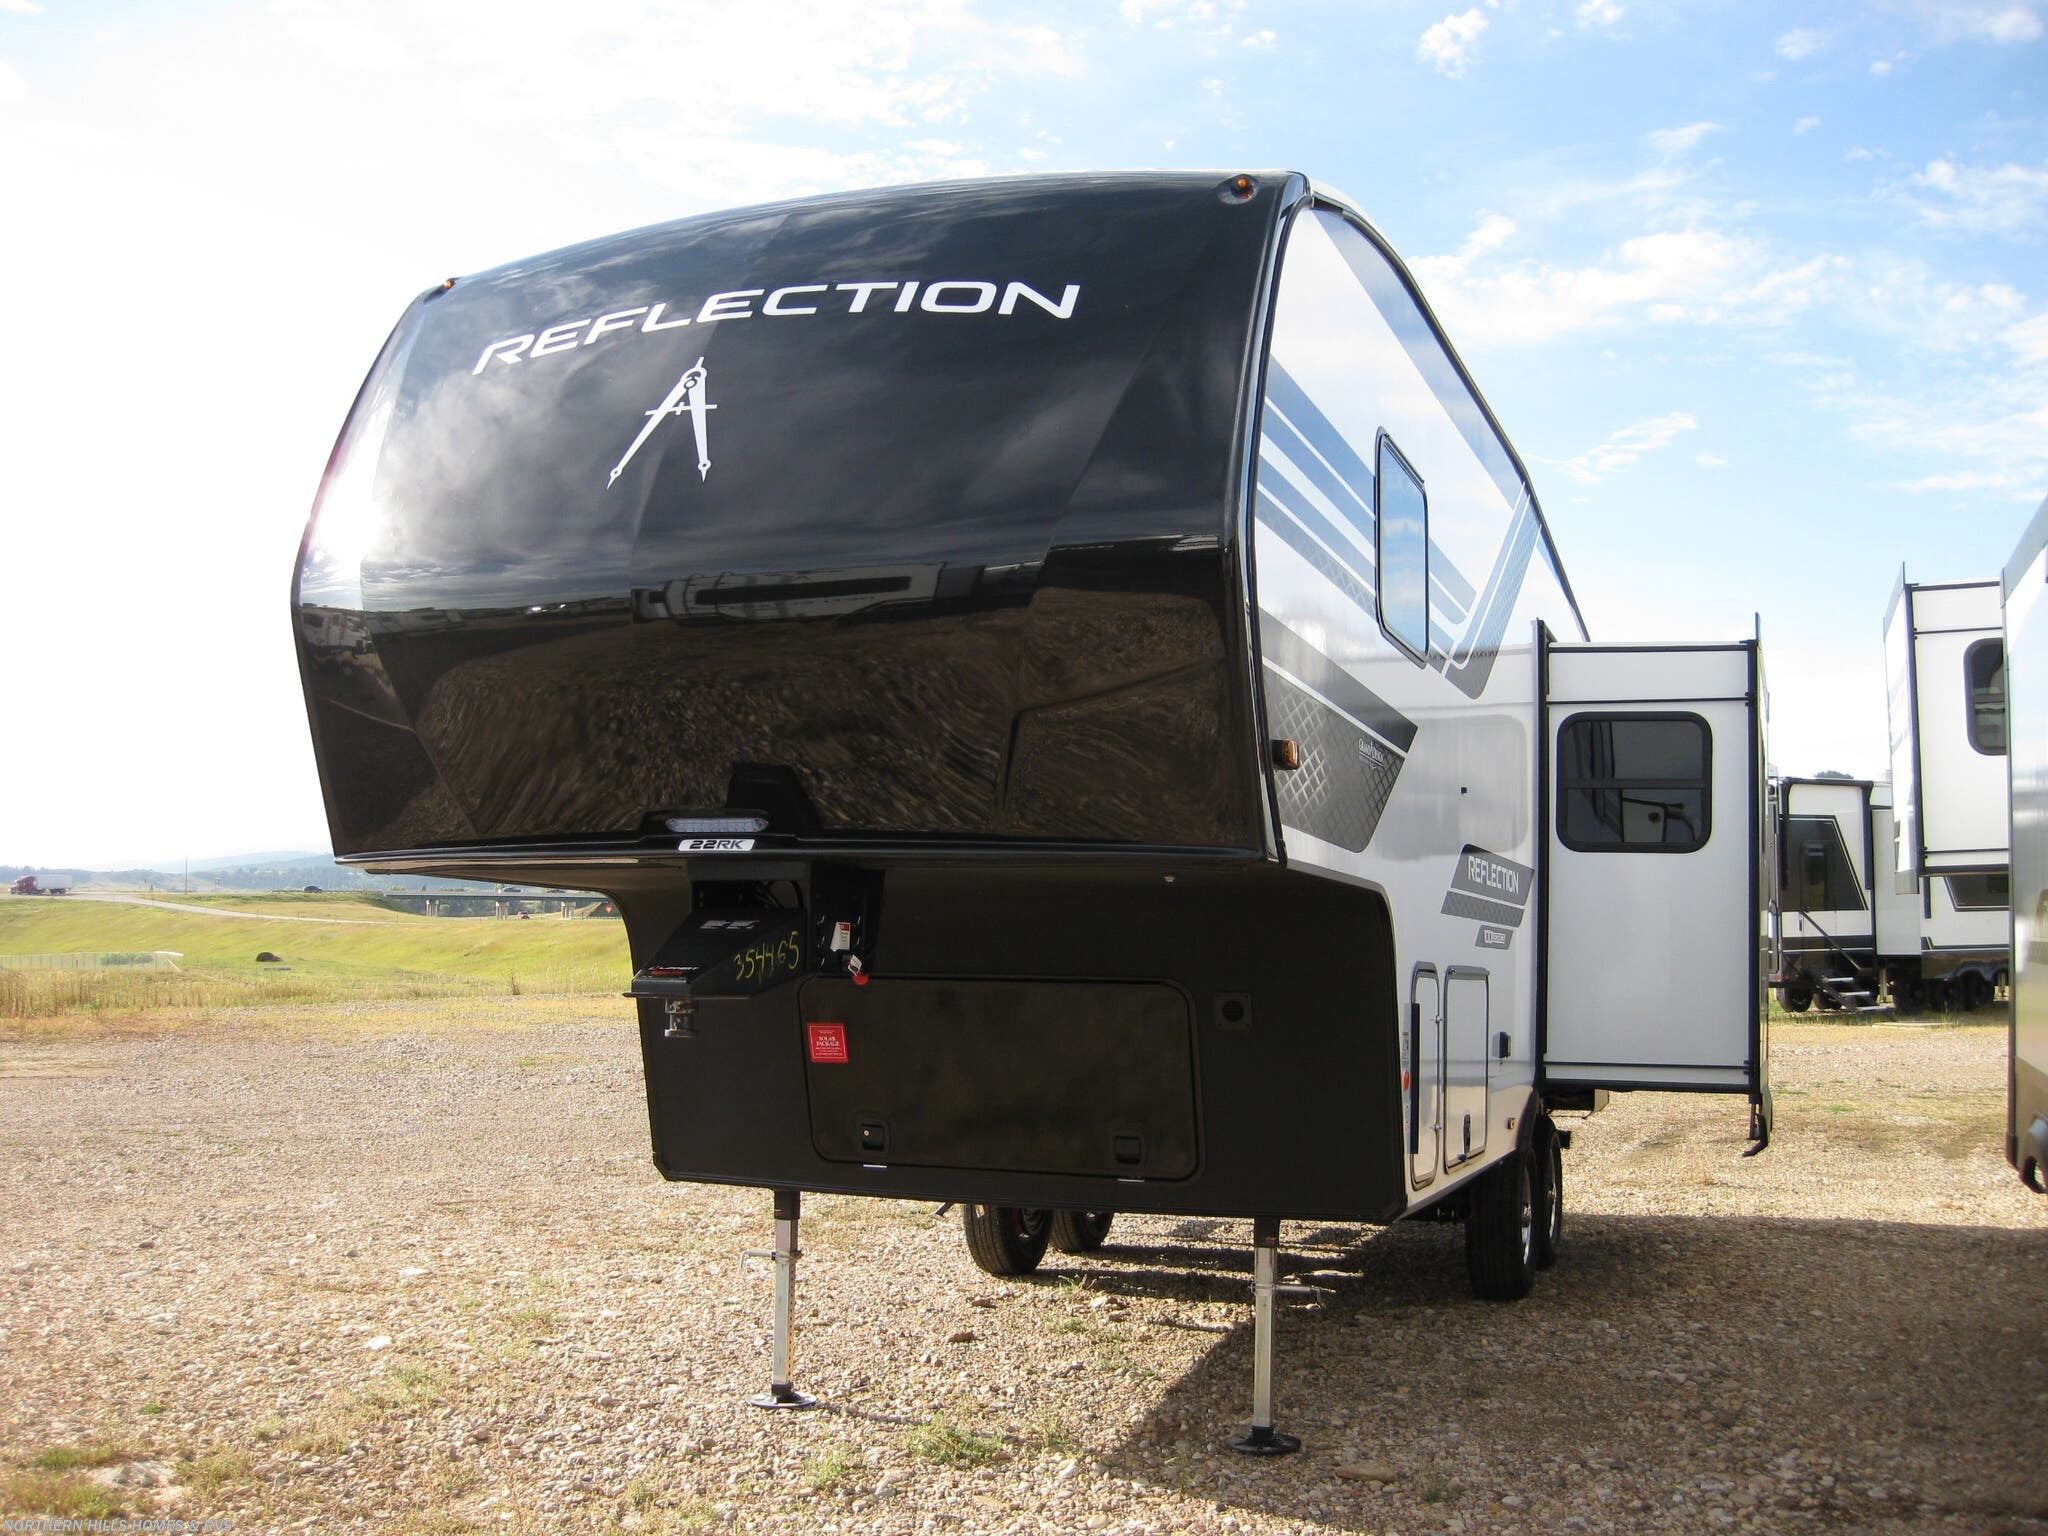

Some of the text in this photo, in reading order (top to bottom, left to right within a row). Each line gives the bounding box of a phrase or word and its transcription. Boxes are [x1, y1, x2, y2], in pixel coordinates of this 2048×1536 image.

[472, 281, 1080, 376] REFLECTION
[689, 839, 744, 850] 22RK
[1467, 855, 1519, 895] REFLECTION
[734, 931, 800, 983] 354465
